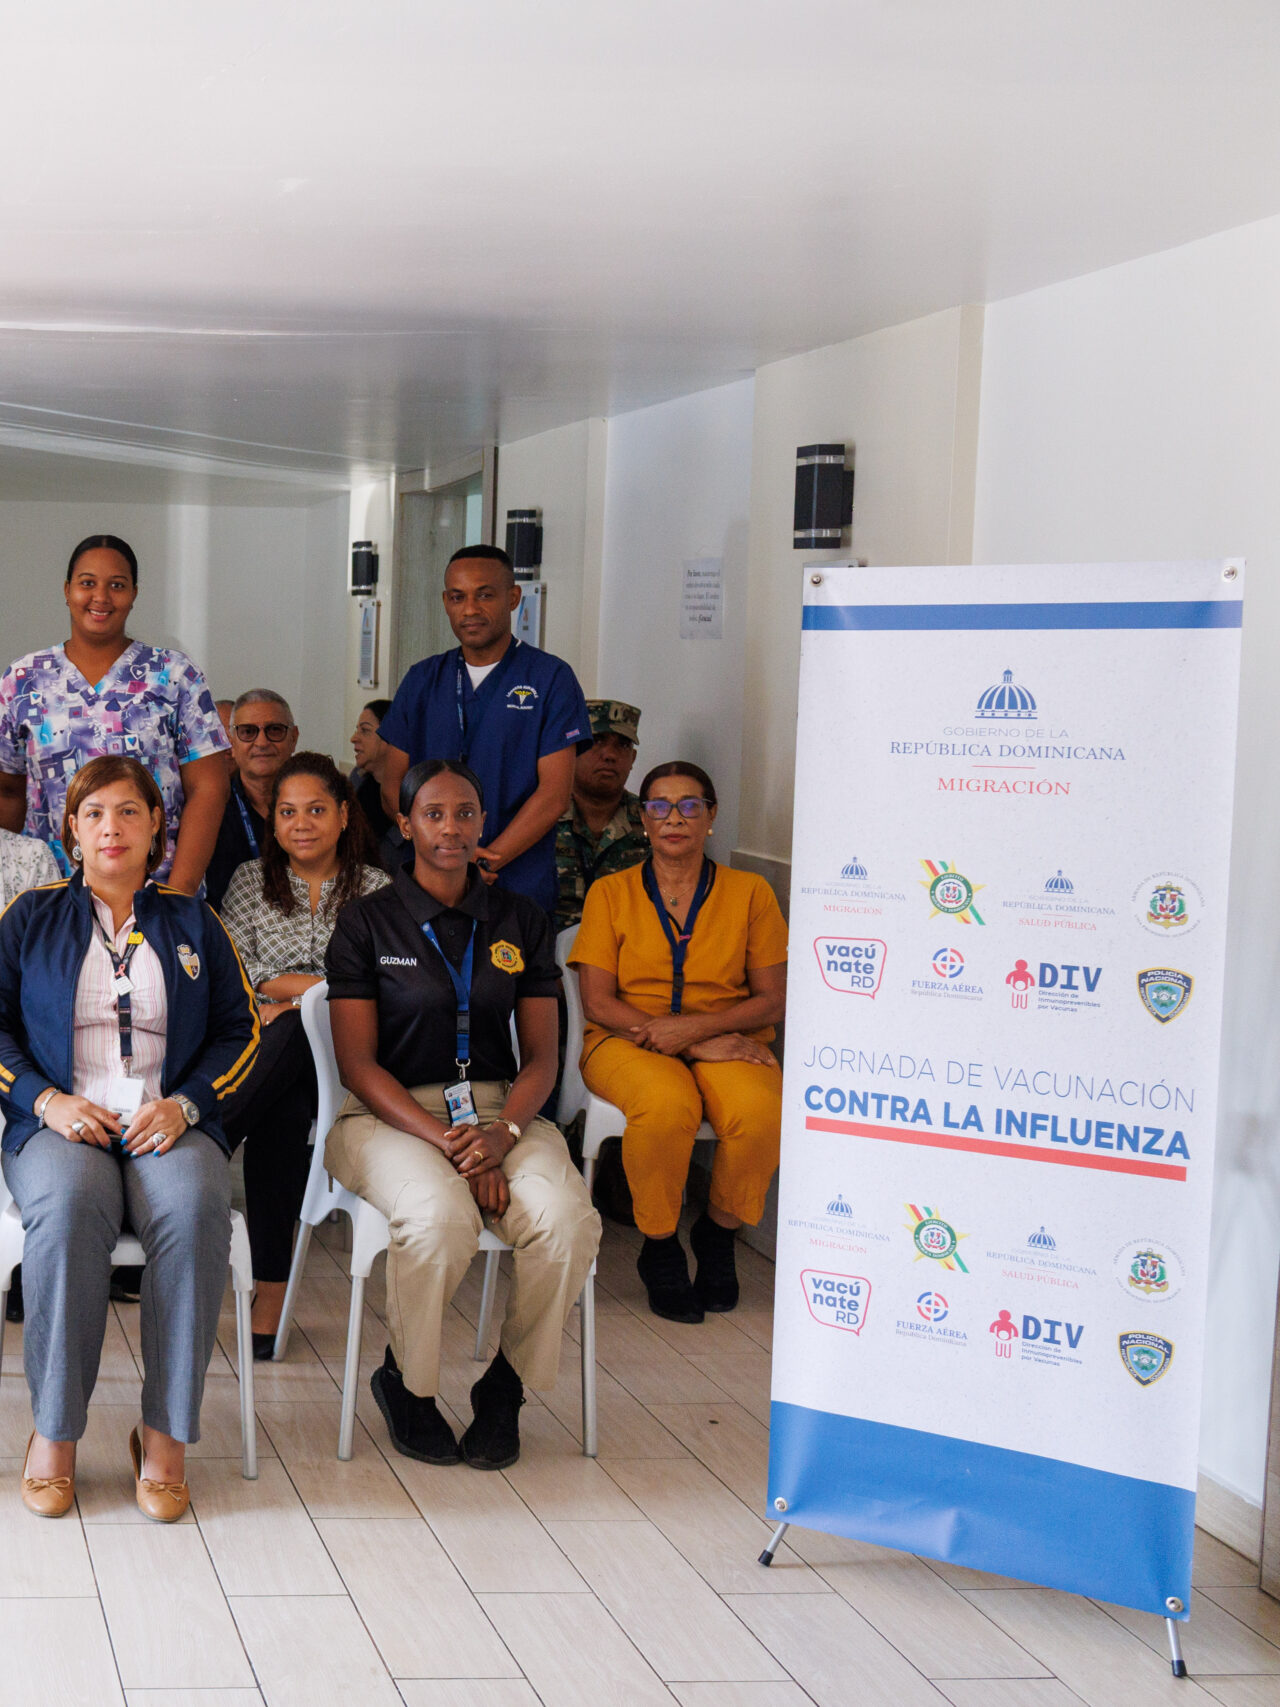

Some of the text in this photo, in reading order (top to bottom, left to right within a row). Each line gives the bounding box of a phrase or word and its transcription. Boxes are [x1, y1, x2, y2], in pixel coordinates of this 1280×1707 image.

[943, 727, 1069, 739] GOBIERNO DE LA
[890, 741, 1126, 761] REPÚBLICA DOMINICANA
[938, 778, 1071, 795] MIGRACIÓN
[826, 943, 876, 960] vacú
[380, 956, 417, 966] GUZMAN
[827, 960, 875, 975] nate
[851, 976, 874, 989] RD
[912, 980, 949, 991] FUERZA
[1039, 963, 1102, 992] DIV
[1140, 976, 1189, 989] NACIONAL
[804, 1045, 1195, 1113] JORNADA DE VACUNACIÓN
[805, 1085, 1191, 1160] CONTRA LA INFLUENZA
[812, 1277, 861, 1296] vacú
[813, 1293, 859, 1312] nate
[836, 1311, 859, 1325] RD
[896, 1320, 934, 1334] FUERZA
[1022, 1315, 1084, 1349] DIV
[1122, 1340, 1170, 1354] NACIONAL
